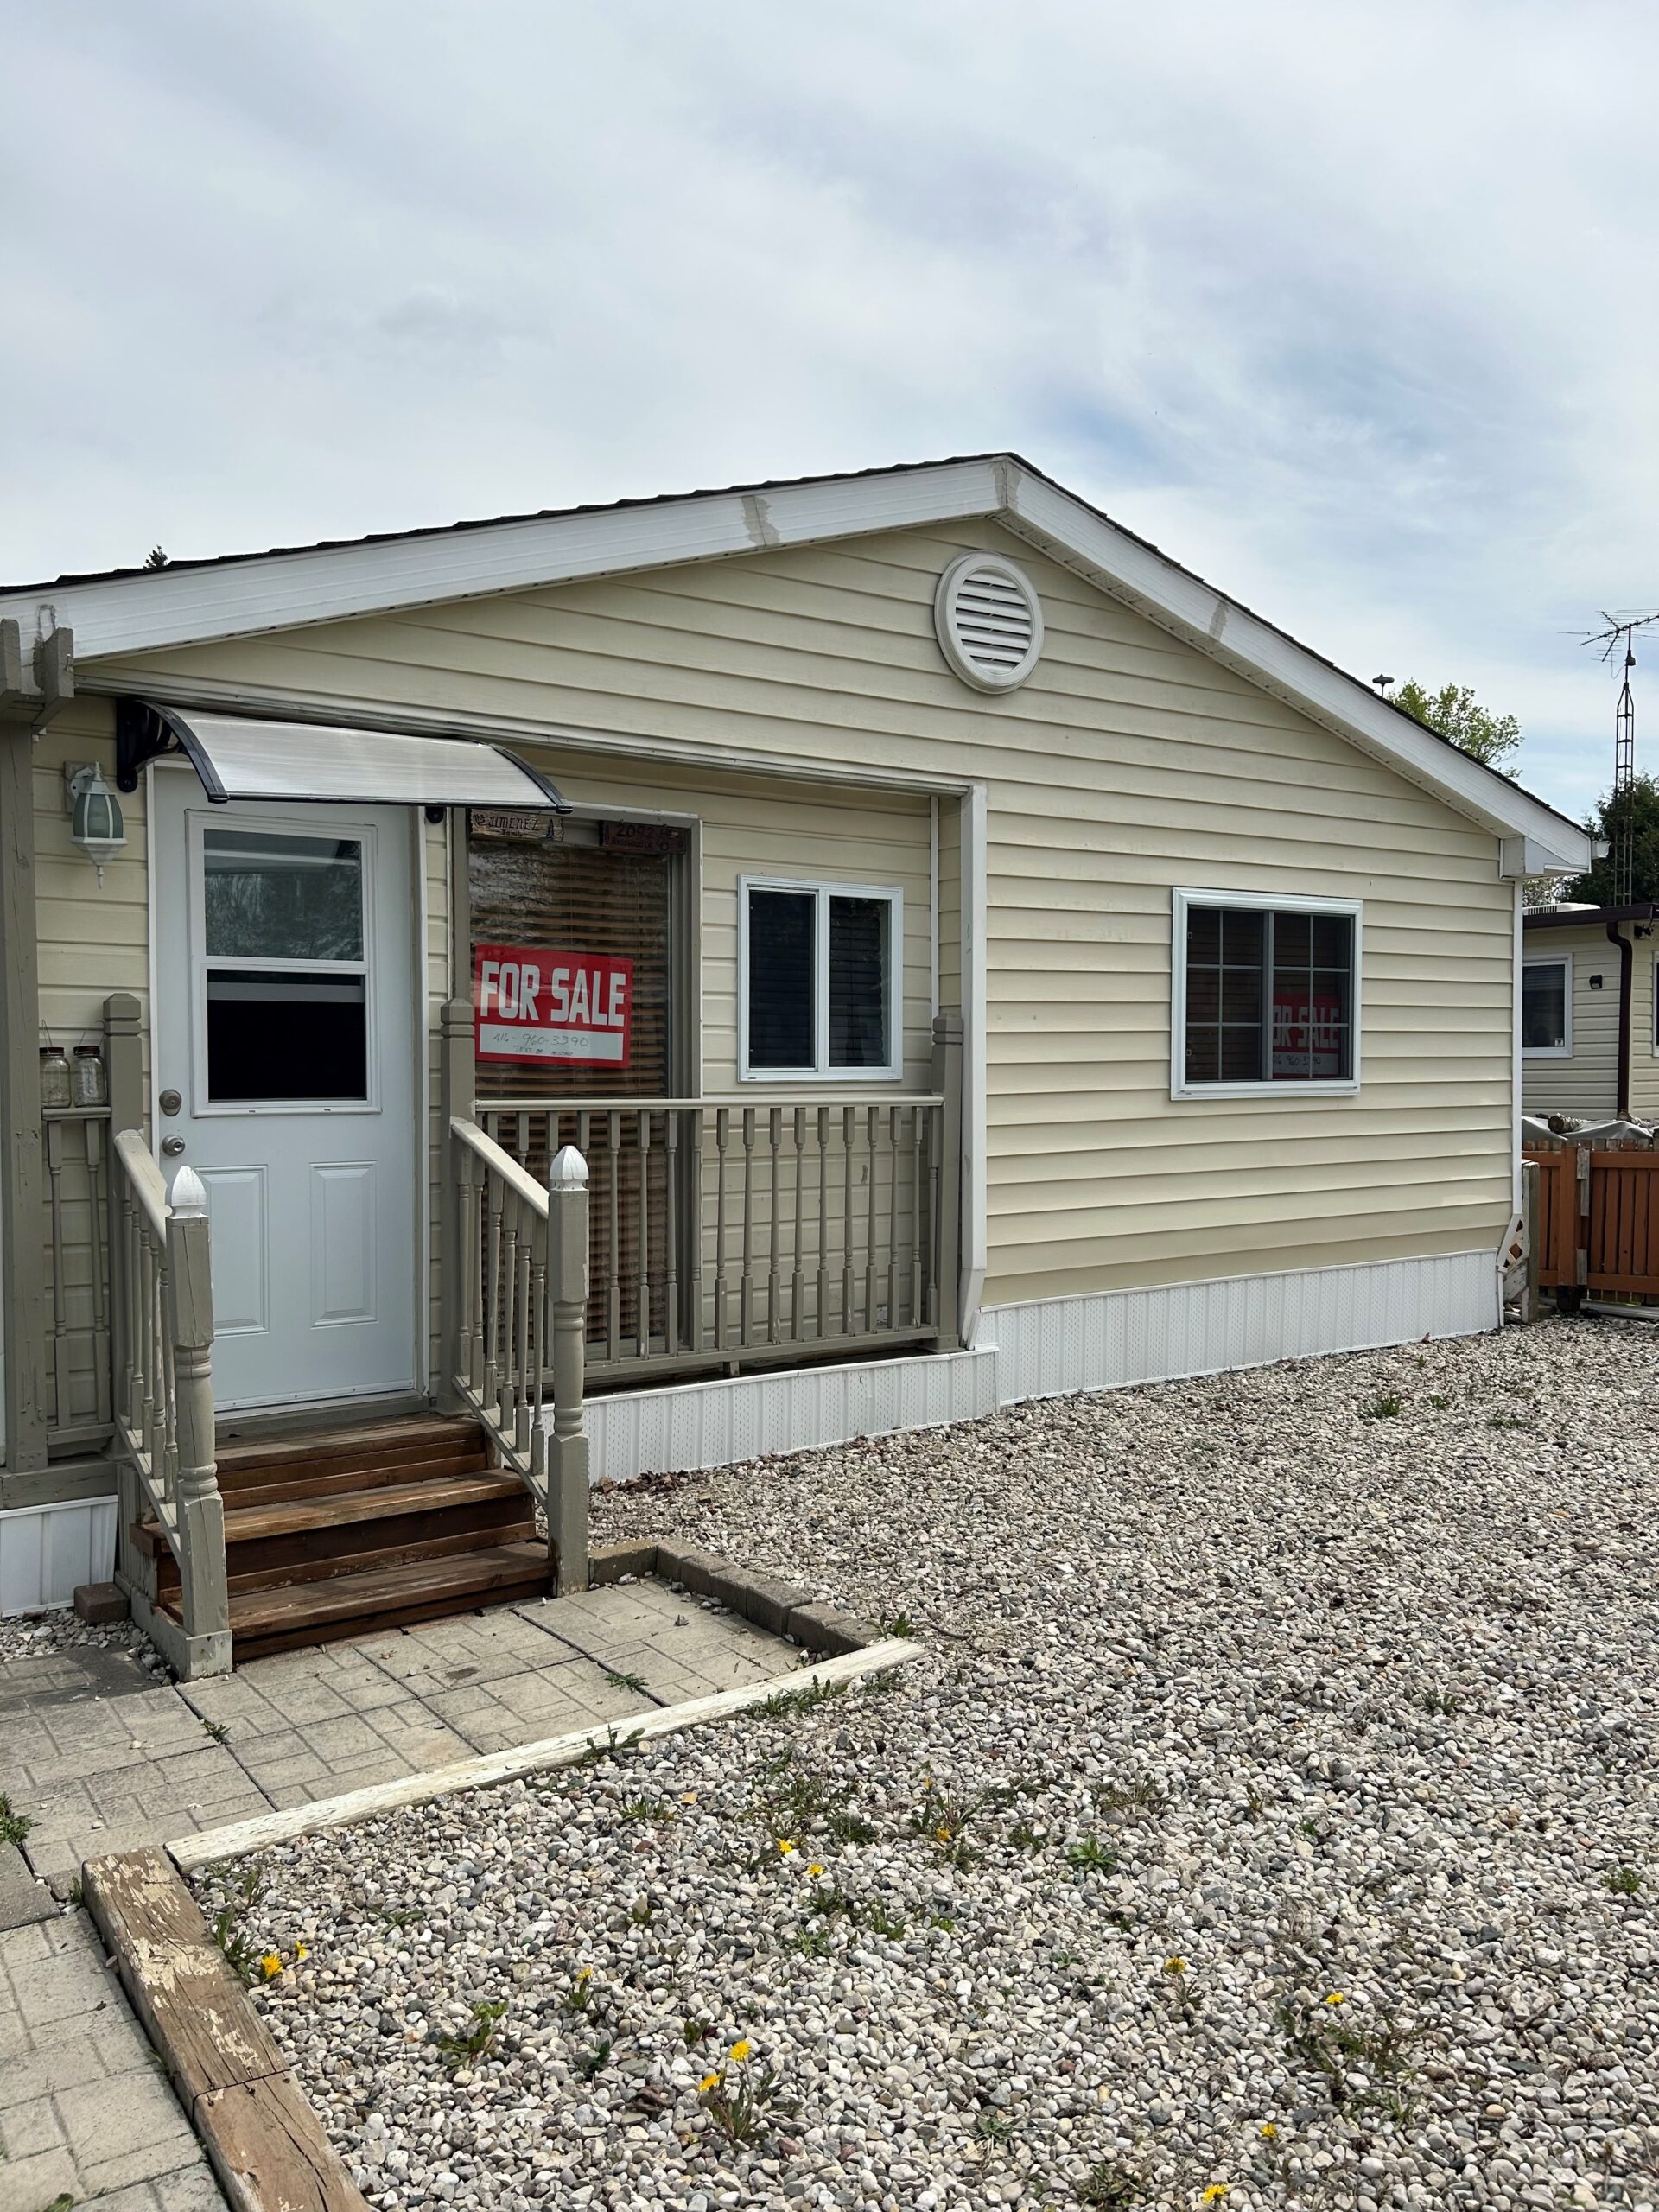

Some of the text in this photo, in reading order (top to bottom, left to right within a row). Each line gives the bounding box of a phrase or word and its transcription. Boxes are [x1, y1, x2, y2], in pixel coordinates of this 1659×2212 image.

[489, 817, 539, 830] JIMENEZ
[480, 961, 626, 1027] FOR SALE
[1273, 1005, 1339, 1048] OR SALE
